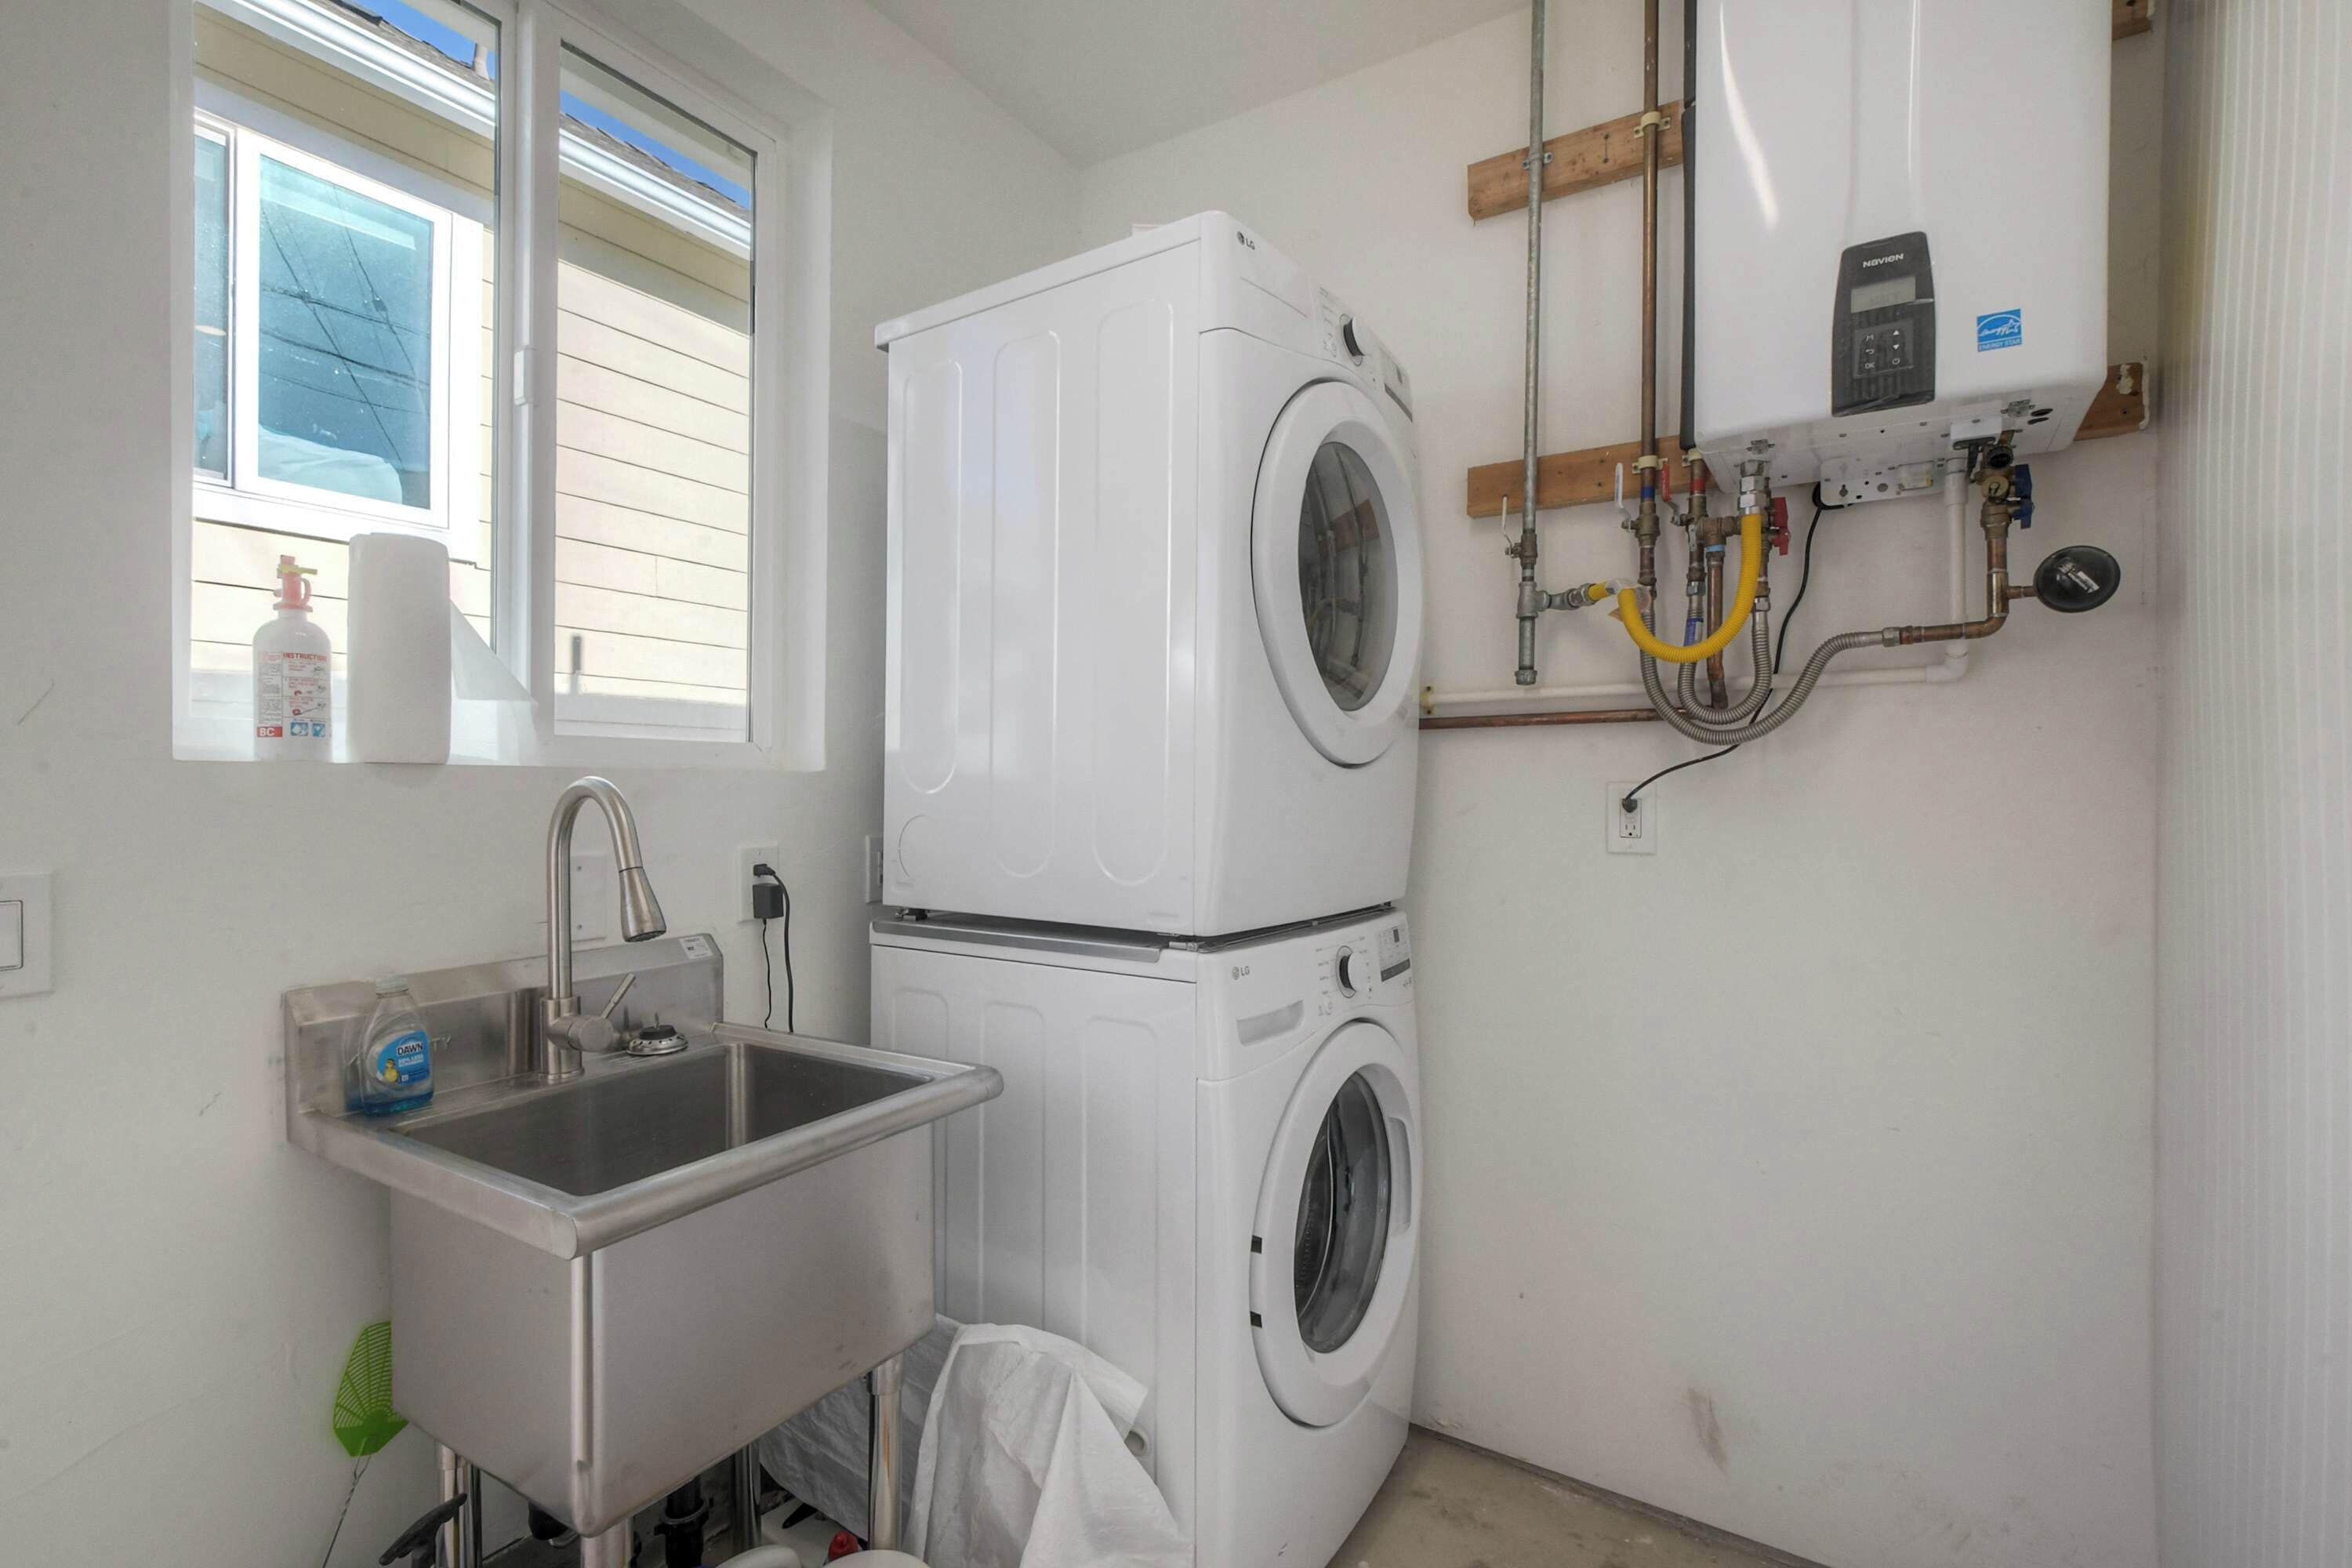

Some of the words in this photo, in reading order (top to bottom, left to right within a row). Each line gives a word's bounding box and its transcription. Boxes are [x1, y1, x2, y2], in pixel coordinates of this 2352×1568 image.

[1246, 238, 1255, 250] LG
[1979, 341, 2003, 350] ENERGY
[2005, 339, 2021, 347] STAR
[259, 727, 275, 737] BC
[1240, 965, 1250, 976] LG
[397, 1042, 423, 1055] DAWN
